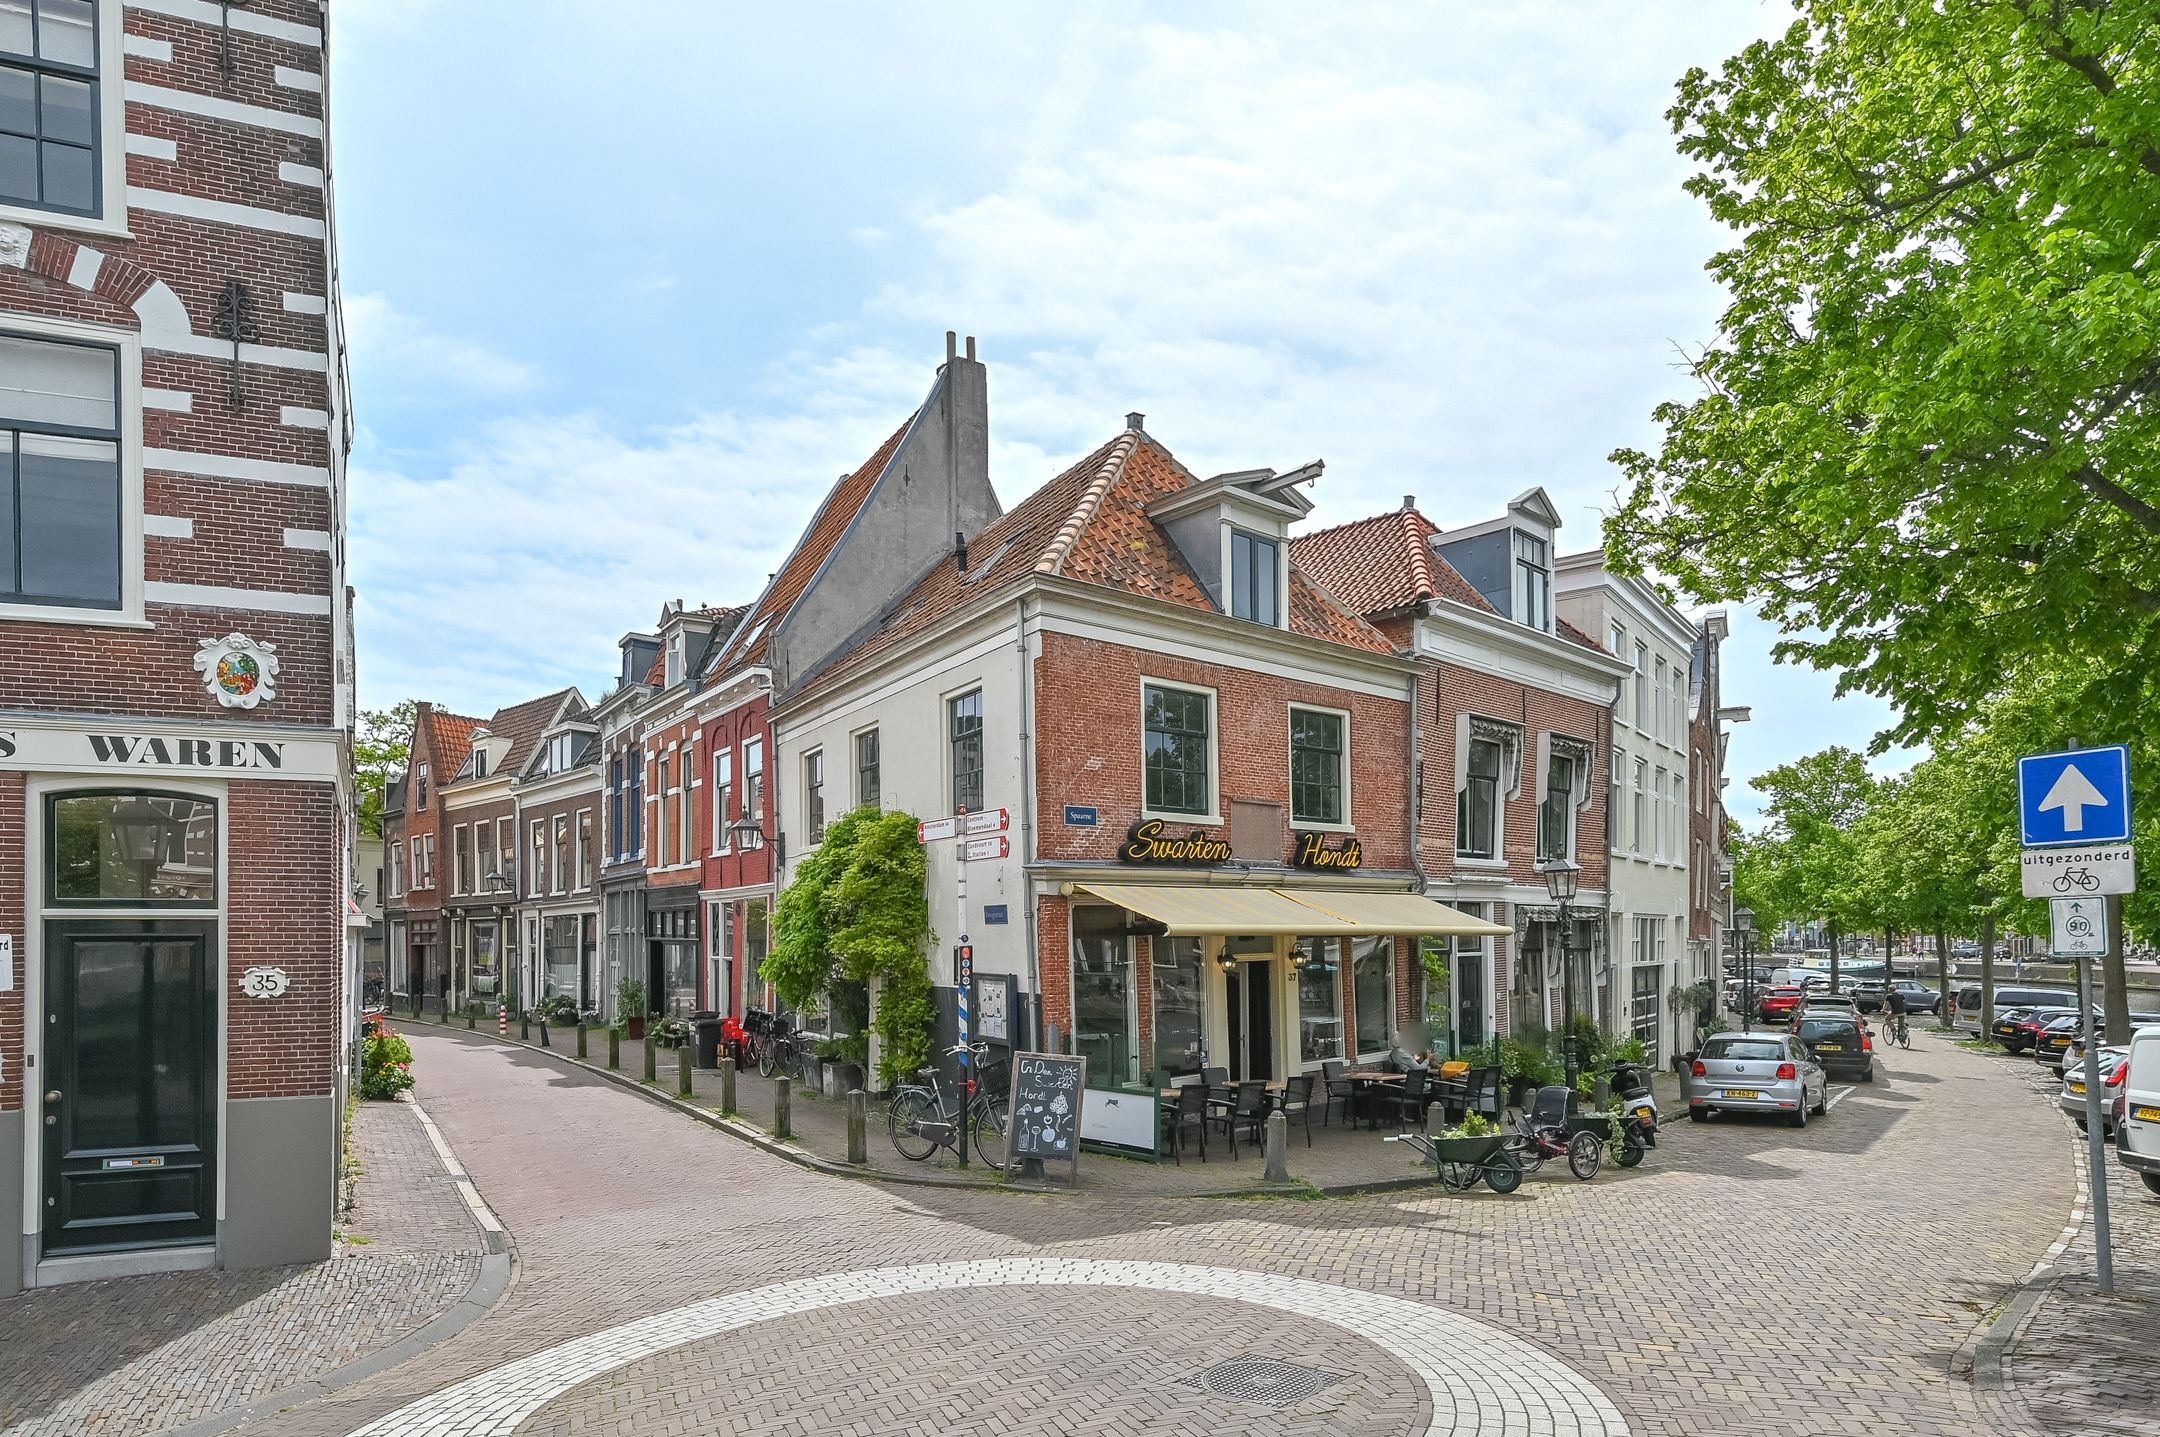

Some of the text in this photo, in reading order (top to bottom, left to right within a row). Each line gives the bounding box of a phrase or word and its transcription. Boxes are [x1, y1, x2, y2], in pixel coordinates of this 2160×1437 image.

[86, 735, 286, 769] WAREN
[1070, 811, 1092, 821] Spaarne
[1128, 820, 1362, 868] Swarten Hondt
[2023, 850, 2130, 867] uitgezonderd
[2069, 921, 2088, 932] 90
[252, 974, 278, 991] 35
[1288, 972, 1297, 982] 37
